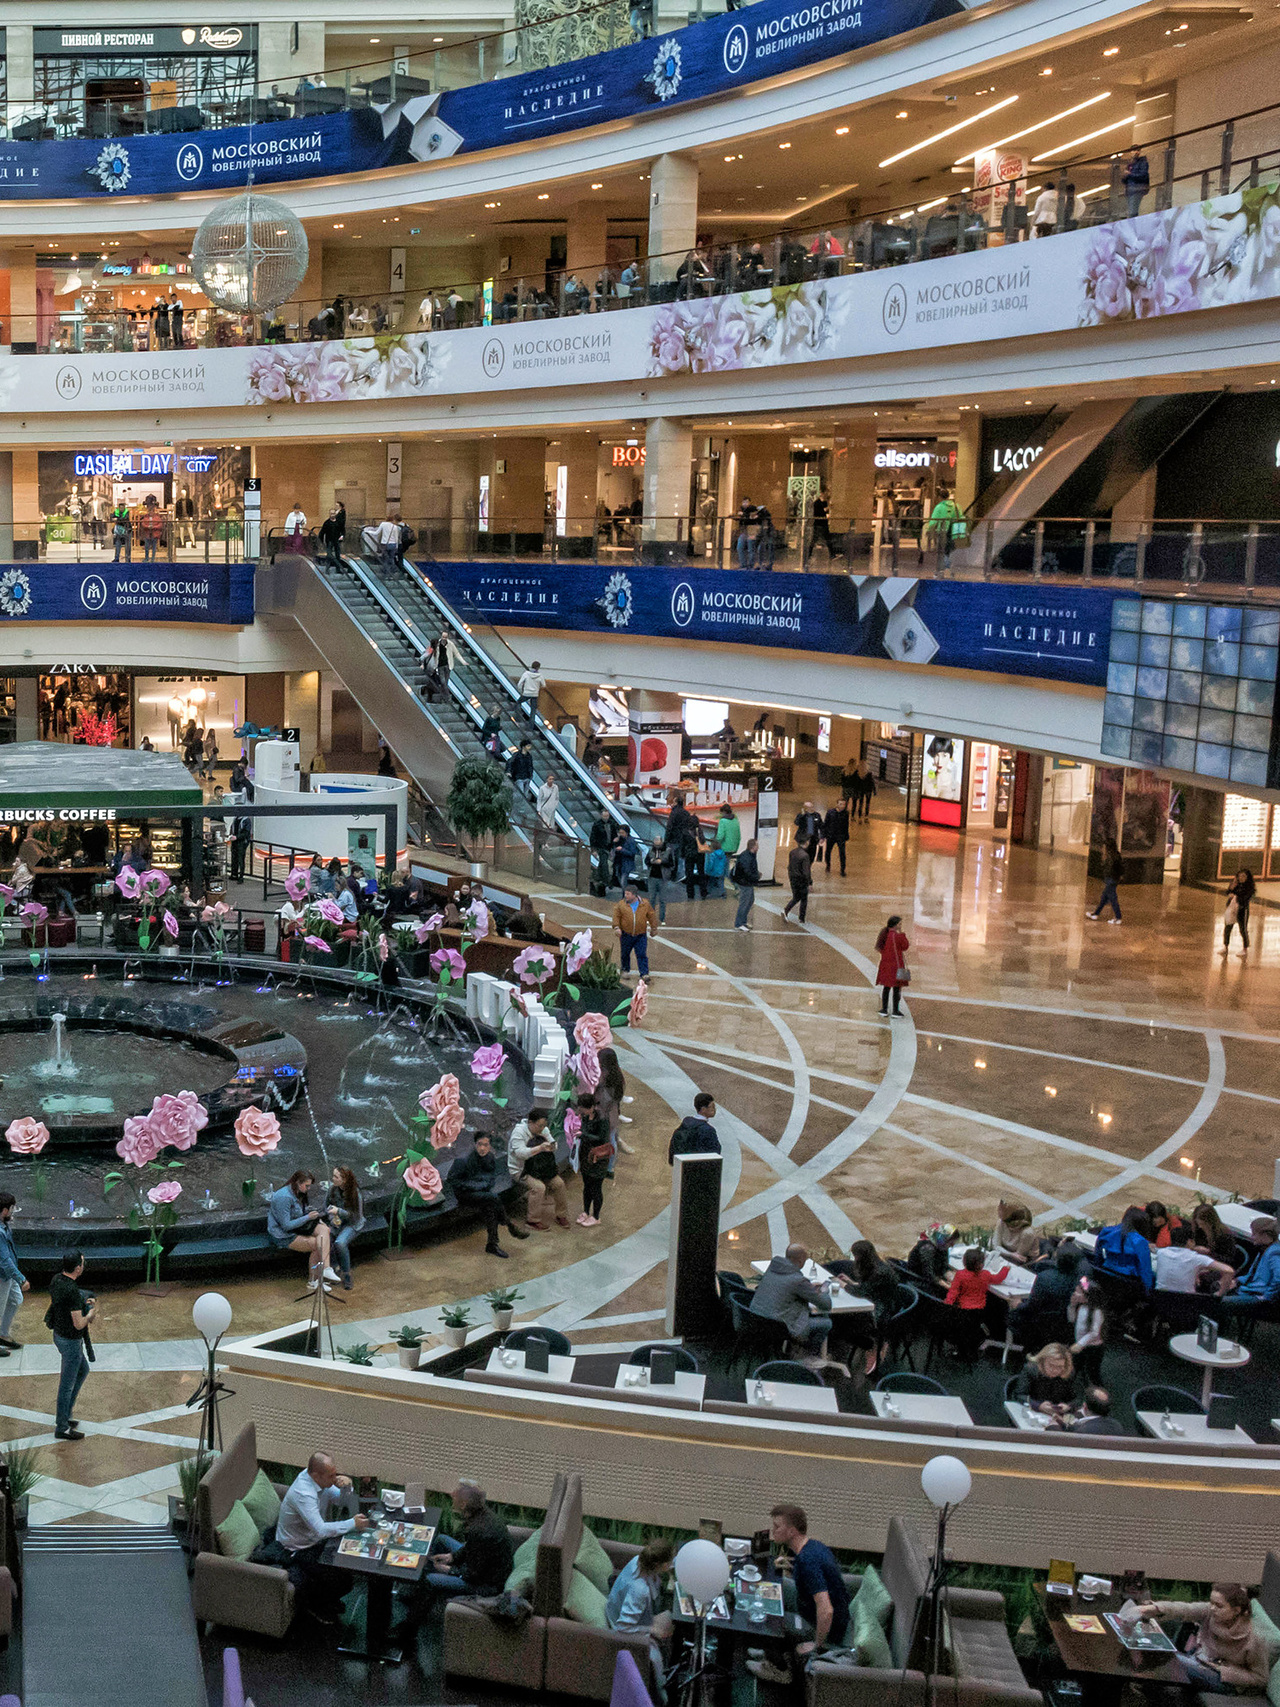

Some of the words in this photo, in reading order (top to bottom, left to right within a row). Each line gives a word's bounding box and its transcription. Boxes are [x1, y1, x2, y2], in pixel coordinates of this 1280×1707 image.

[61, 32, 102, 46] ПИВНОЙ
[104, 33, 154, 46] РЕСТОРАН
[755, 24, 824, 58] ЮВЕЛИРНЫЙ
[826, 12, 862, 35] ЗАВОД
[396, 61, 406, 75] 5
[504, 84, 604, 118] НАСЛЕДИЕ
[212, 131, 321, 160] МОСКОВСКИЙ
[211, 153, 282, 172] ЮВЕЛИРНЫЙ
[285, 151, 320, 164] ЗАВОД
[1000, 165, 1023, 177] KING
[393, 263, 403, 279] 4
[916, 265, 1030, 305] МОСКОВСКИЙ
[915, 298, 988, 323] ЮВЕЛИРНЫЙ
[991, 294, 1028, 312] ЗАВОД
[512, 329, 612, 356] МОСКОВСКИЙ
[512, 352, 576, 369] ЮВЕЛИРНЫЙ
[578, 351, 611, 364] ЗАВОД
[91, 363, 205, 382] МОСКОВСКИЙ
[92, 382, 165, 394] ЮВЕЛИРНЫЙ
[168, 381, 205, 393] ЗАВОД
[612, 446, 647, 462] BOS
[874, 450, 930, 468] ellson
[993, 446, 1043, 472] LACO
[75, 454, 138, 475] CASUAL
[141, 454, 170, 474] DAY
[186, 460, 211, 472] CITY
[389, 457, 399, 474] 3
[248, 479, 256, 491] 3
[116, 579, 209, 594] МОСКОВСКИЙ
[116, 594, 180, 605] ЮВЕЛИРНЫЙ
[182, 597, 208, 609] ЗАВОД
[463, 591, 558, 604] НАСЛЕДИЕ
[702, 592, 802, 612] МОСКОВСКИЙ
[1005, 605, 1077, 619] ДРАГОЦЕННОЕ
[701, 610, 764, 626] ЮВЕЛИРНЫЙ
[766, 615, 800, 632] ЗАВОД
[983, 623, 1096, 647] НАСЛЕДИЕ
[49, 663, 97, 674] ZARA
[287, 729, 295, 742] 2
[765, 776, 773, 791] 2
[59, 809, 116, 820] COFFEE
